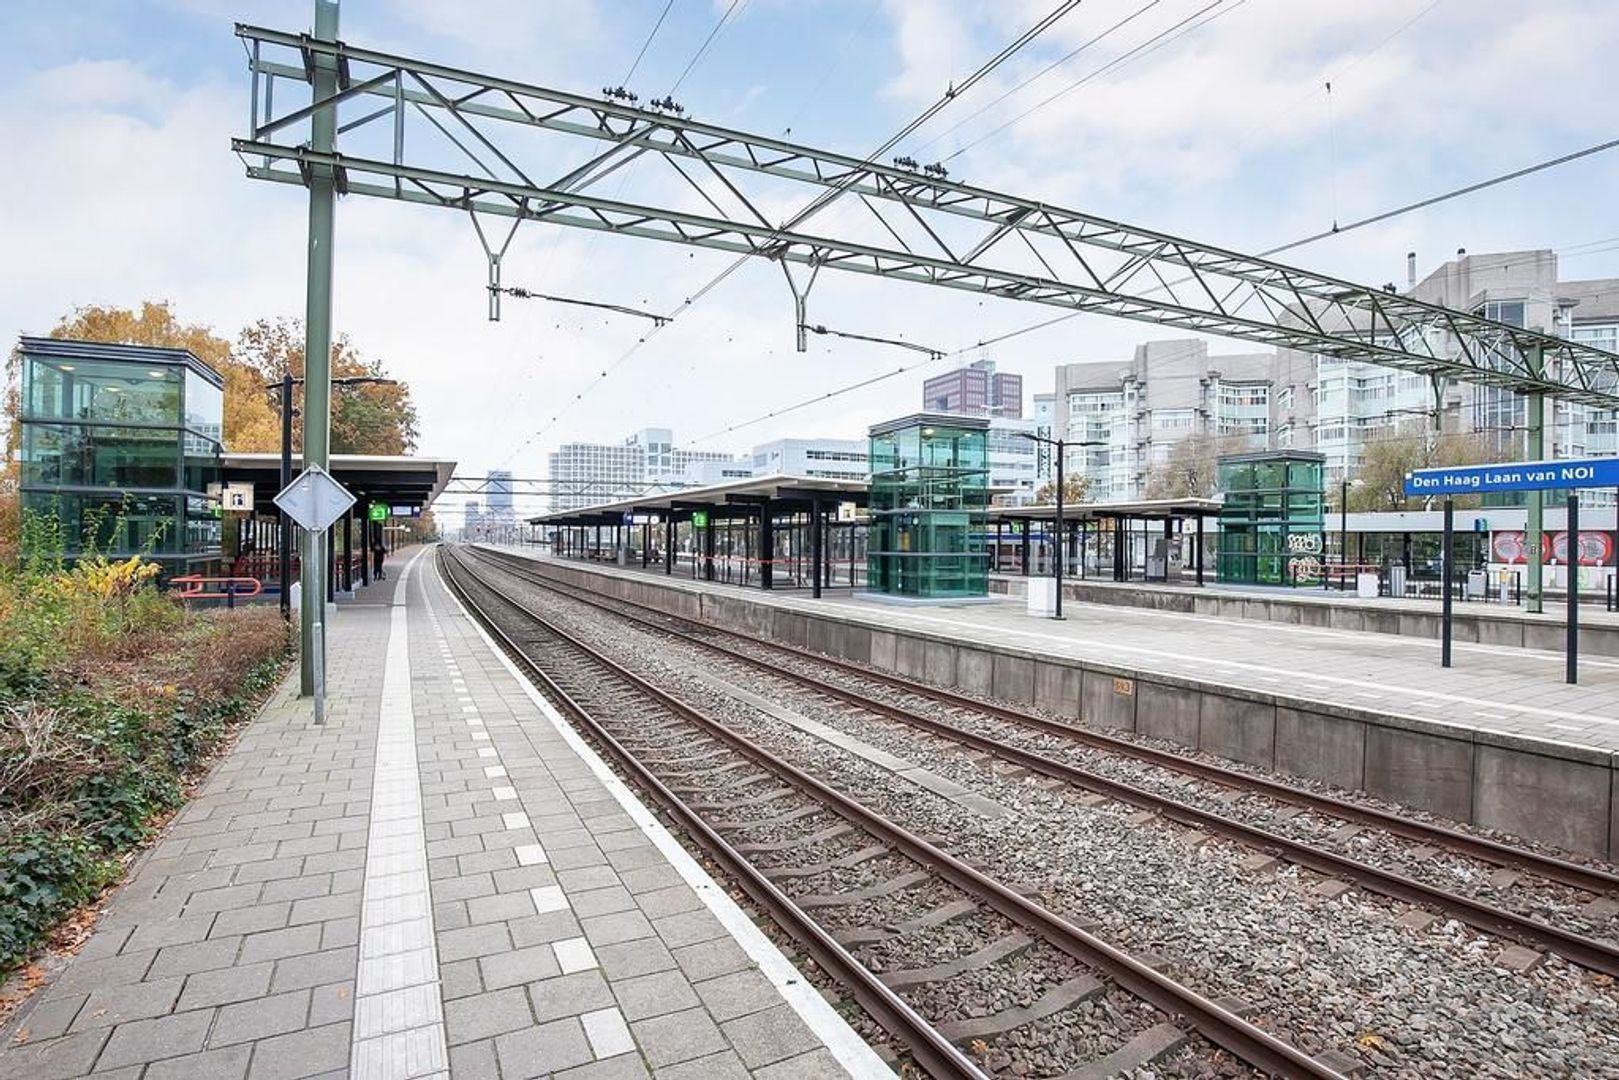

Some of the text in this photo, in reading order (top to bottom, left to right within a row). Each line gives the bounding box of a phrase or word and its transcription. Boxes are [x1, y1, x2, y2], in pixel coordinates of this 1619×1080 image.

[1413, 467, 1594, 487] Den Haag Laan van NOI
